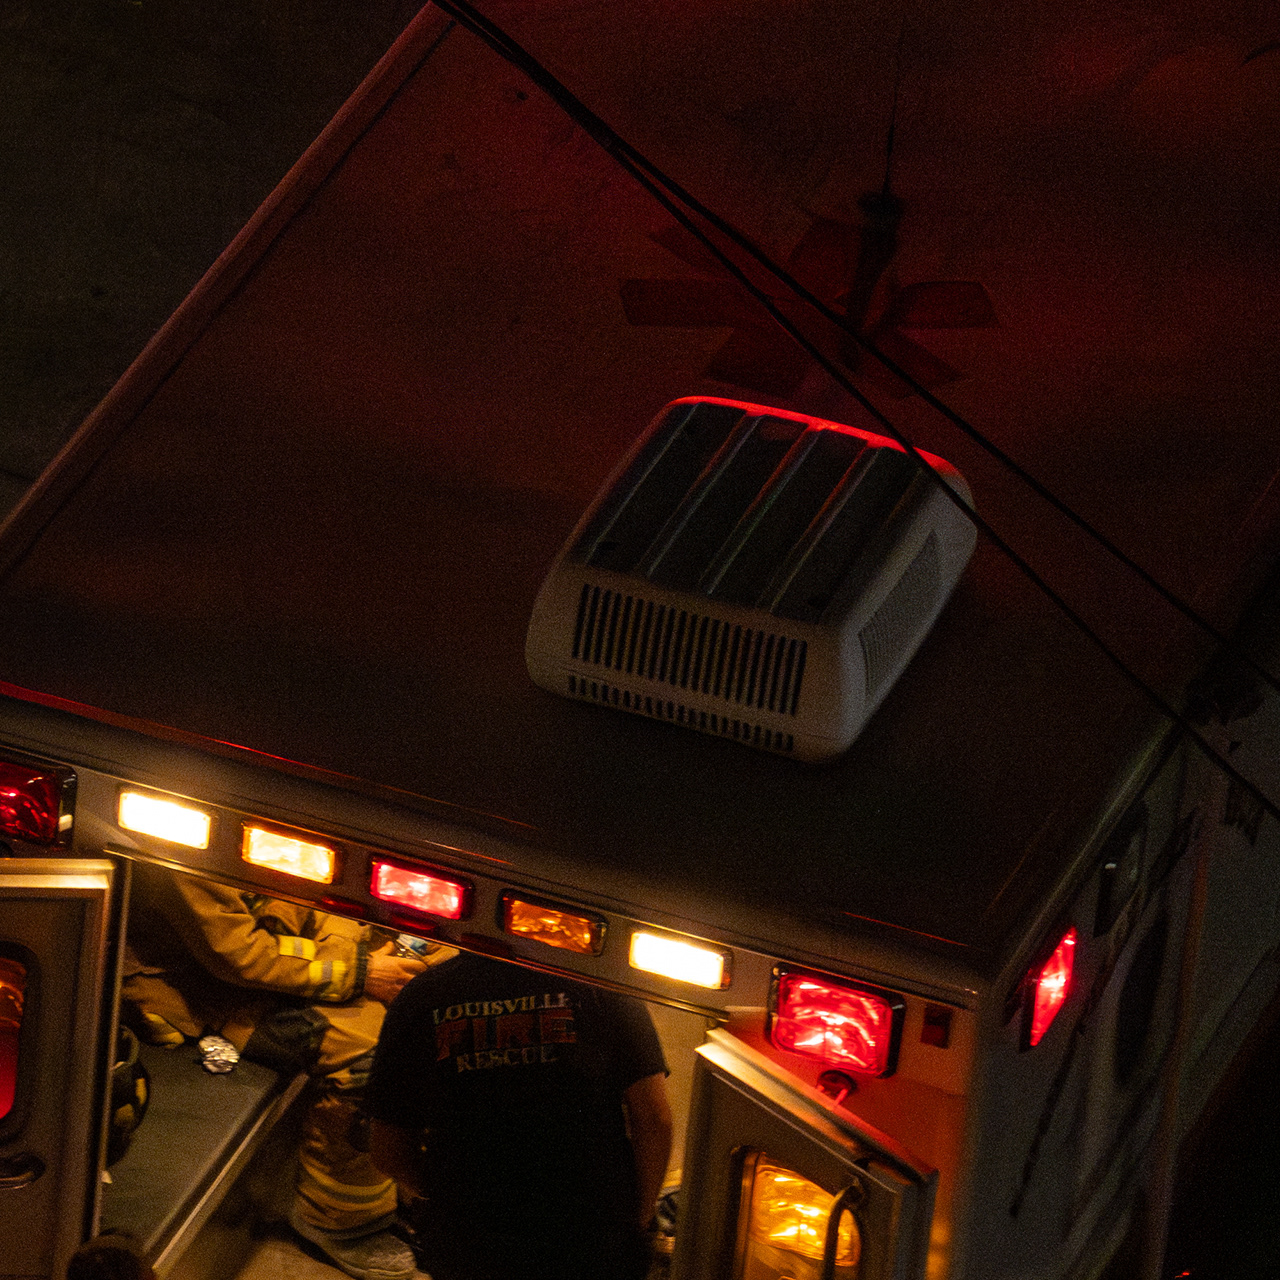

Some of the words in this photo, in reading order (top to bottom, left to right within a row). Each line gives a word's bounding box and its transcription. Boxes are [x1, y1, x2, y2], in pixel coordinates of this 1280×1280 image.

[431, 991, 572, 1025] LOUISVILLE
[435, 1008, 577, 1062] FIRE
[455, 1044, 560, 1074] RESCUE
